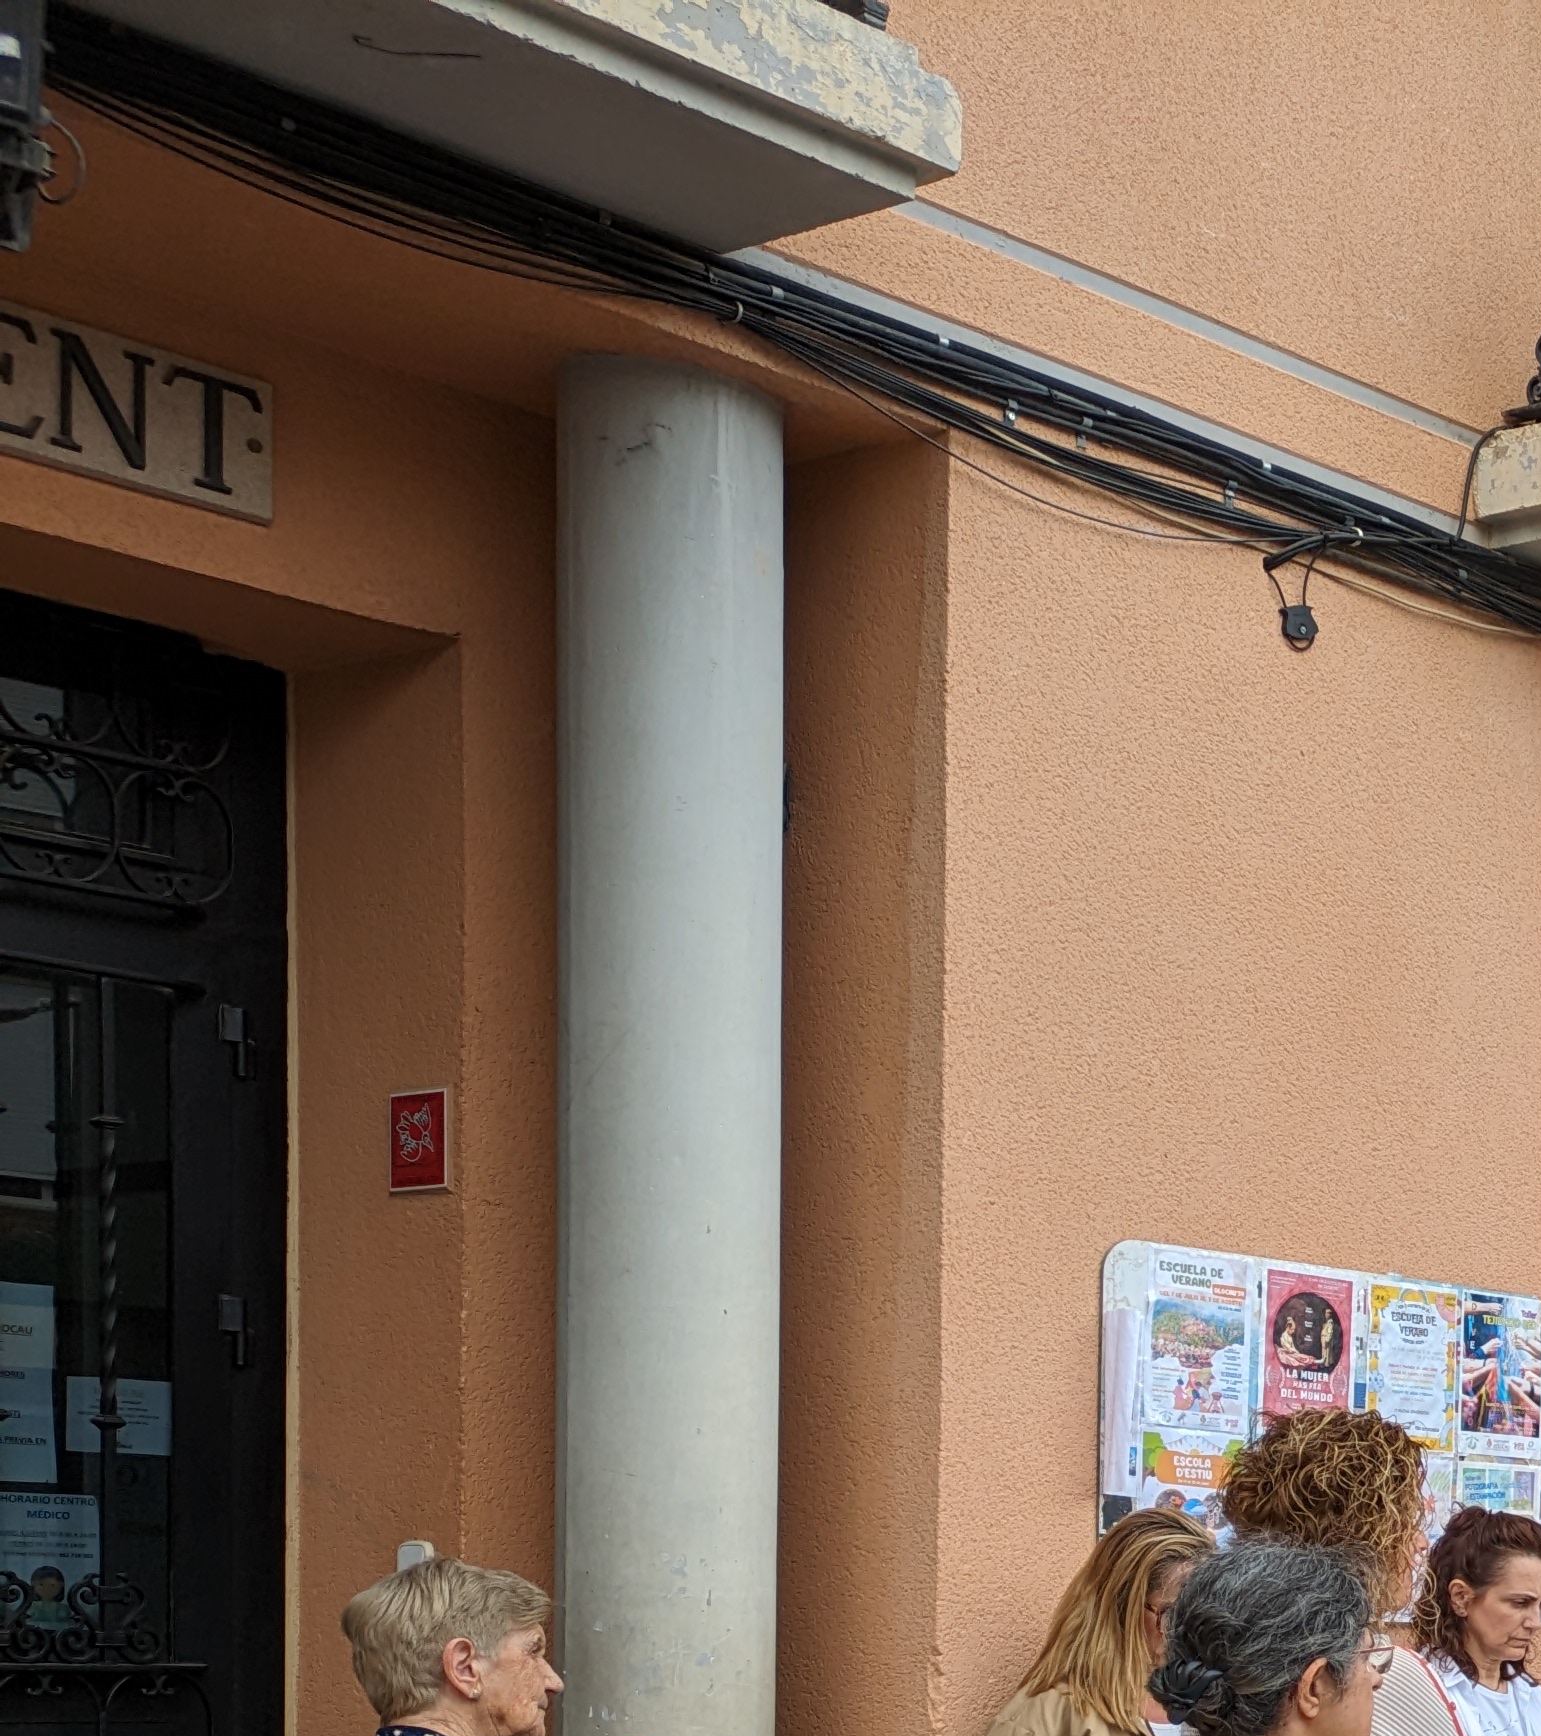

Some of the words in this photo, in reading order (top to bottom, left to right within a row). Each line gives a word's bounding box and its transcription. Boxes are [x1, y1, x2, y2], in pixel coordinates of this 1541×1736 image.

[1159, 1260, 1207, 1277] ESCUELA
[1210, 1267, 1224, 1279] DE
[1171, 1273, 1212, 1289] VERANO
[1391, 1311, 1425, 1325] ESCUELA
[1425, 1315, 1438, 1327] DE
[1398, 1322, 1429, 1338] VERANO
[1286, 1368, 1298, 1379] LA
[1300, 1370, 1329, 1383] MUJER
[1280, 1388, 1298, 1399] DEL
[1300, 1390, 1333, 1403] MUNDO
[1173, 1455, 1212, 1469] ESCOLA
[1176, 1467, 1213, 1481] D'ESTIU
[0, 1493, 51, 1505] HORARIO
[53, 1495, 96, 1507] CENTRO
